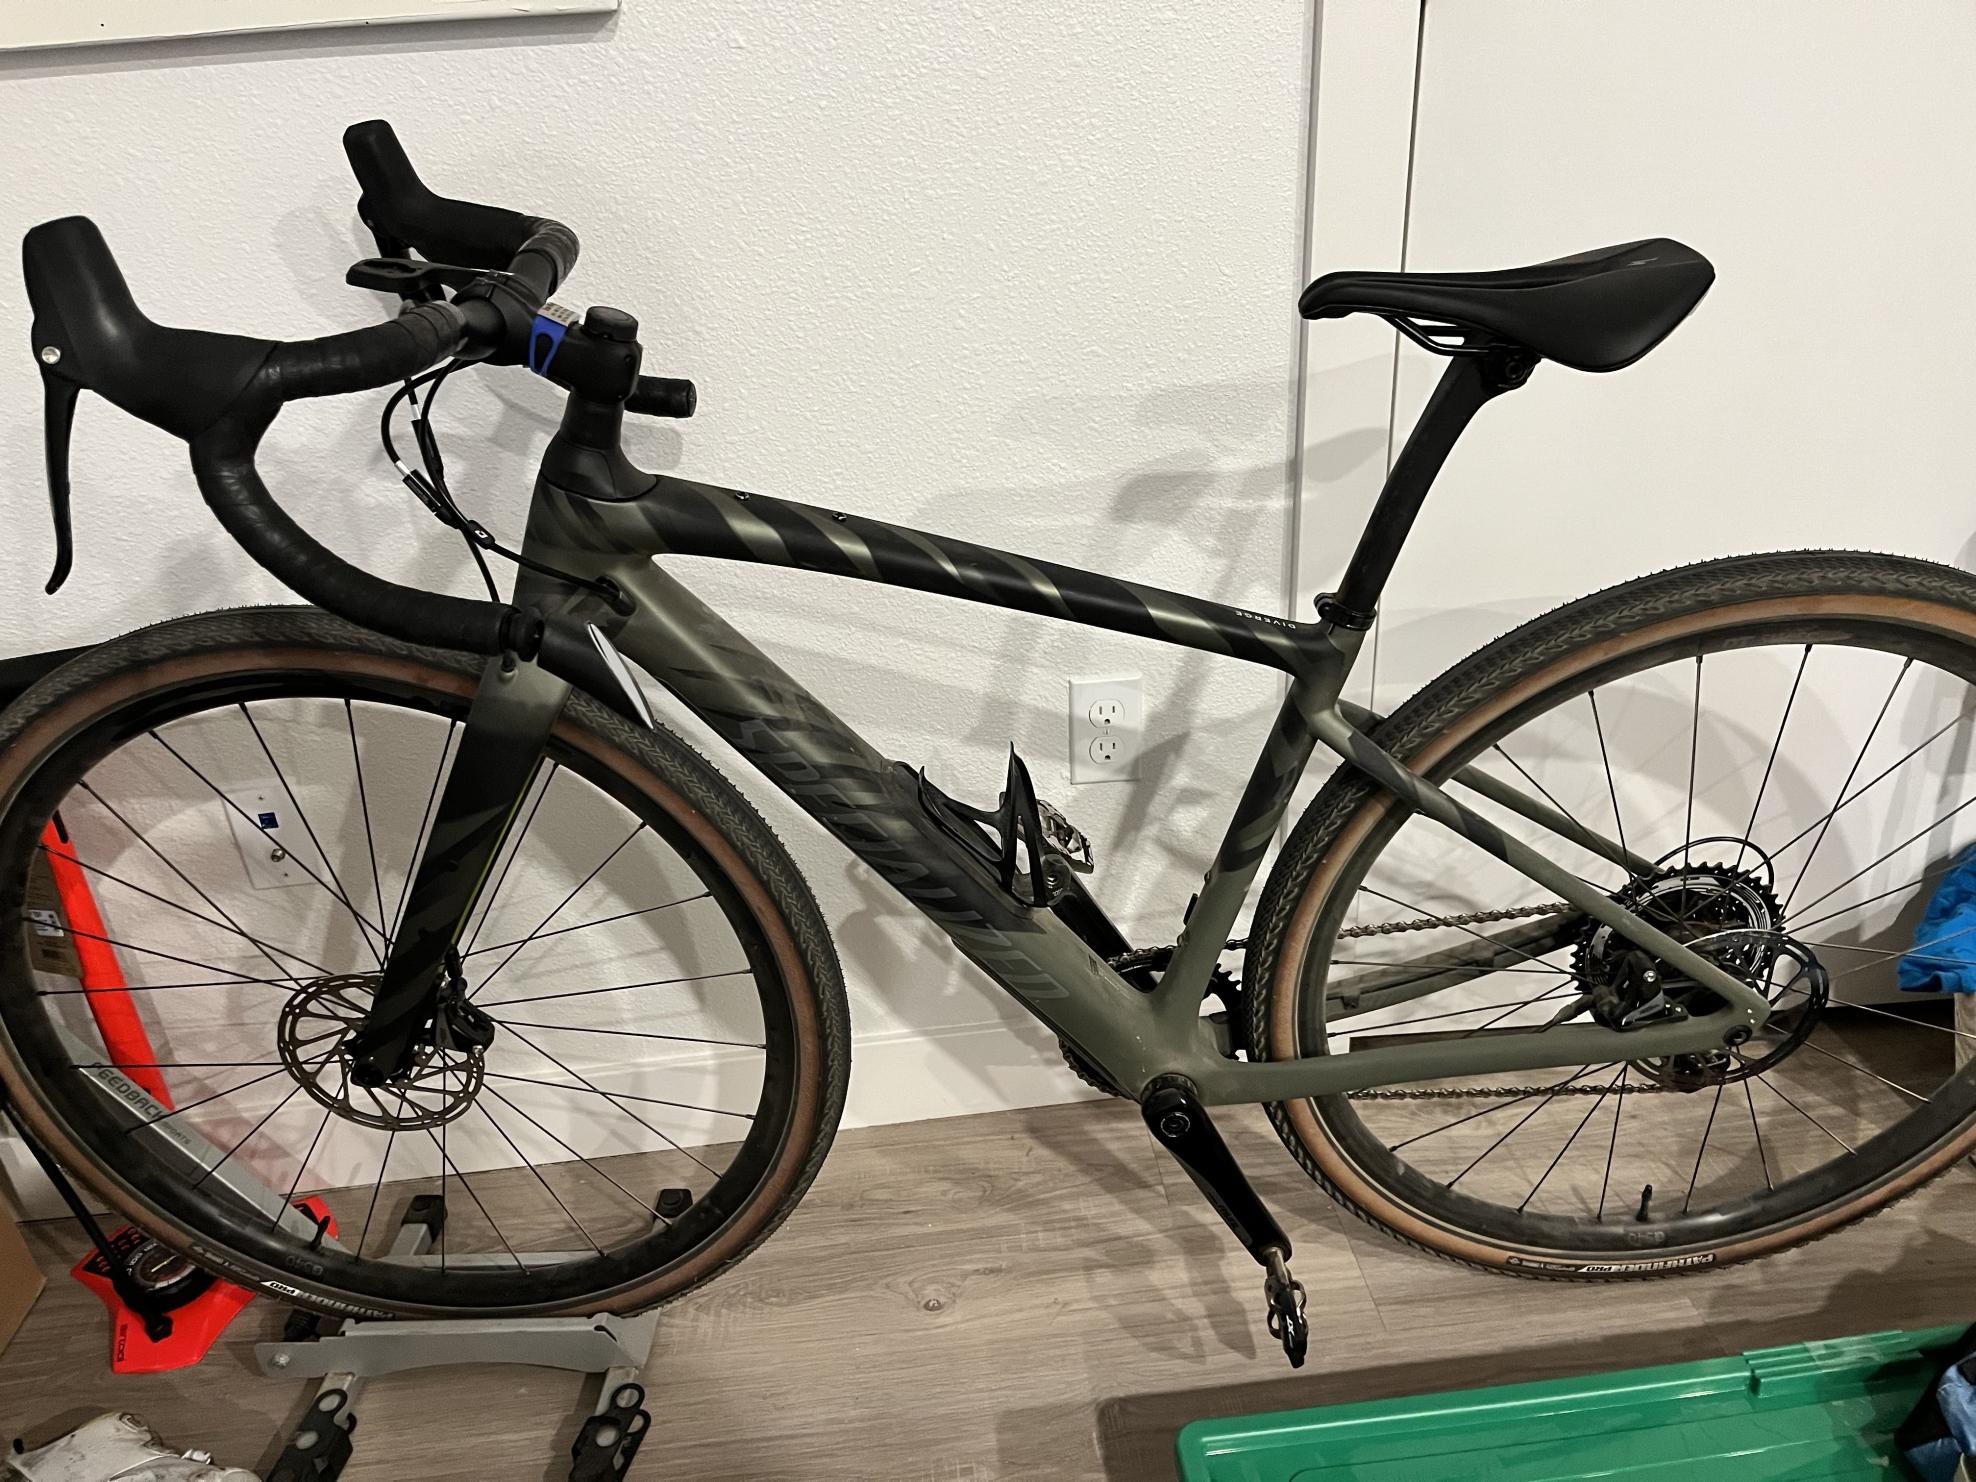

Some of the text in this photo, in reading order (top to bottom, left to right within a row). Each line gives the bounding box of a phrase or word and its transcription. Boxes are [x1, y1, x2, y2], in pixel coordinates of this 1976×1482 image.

[1235, 610, 1296, 630] DIVERGE
[1586, 1265, 1613, 1273] PRO
[1611, 1254, 1714, 1273] PATHFINDER
[269, 1281, 297, 1296] PRO
